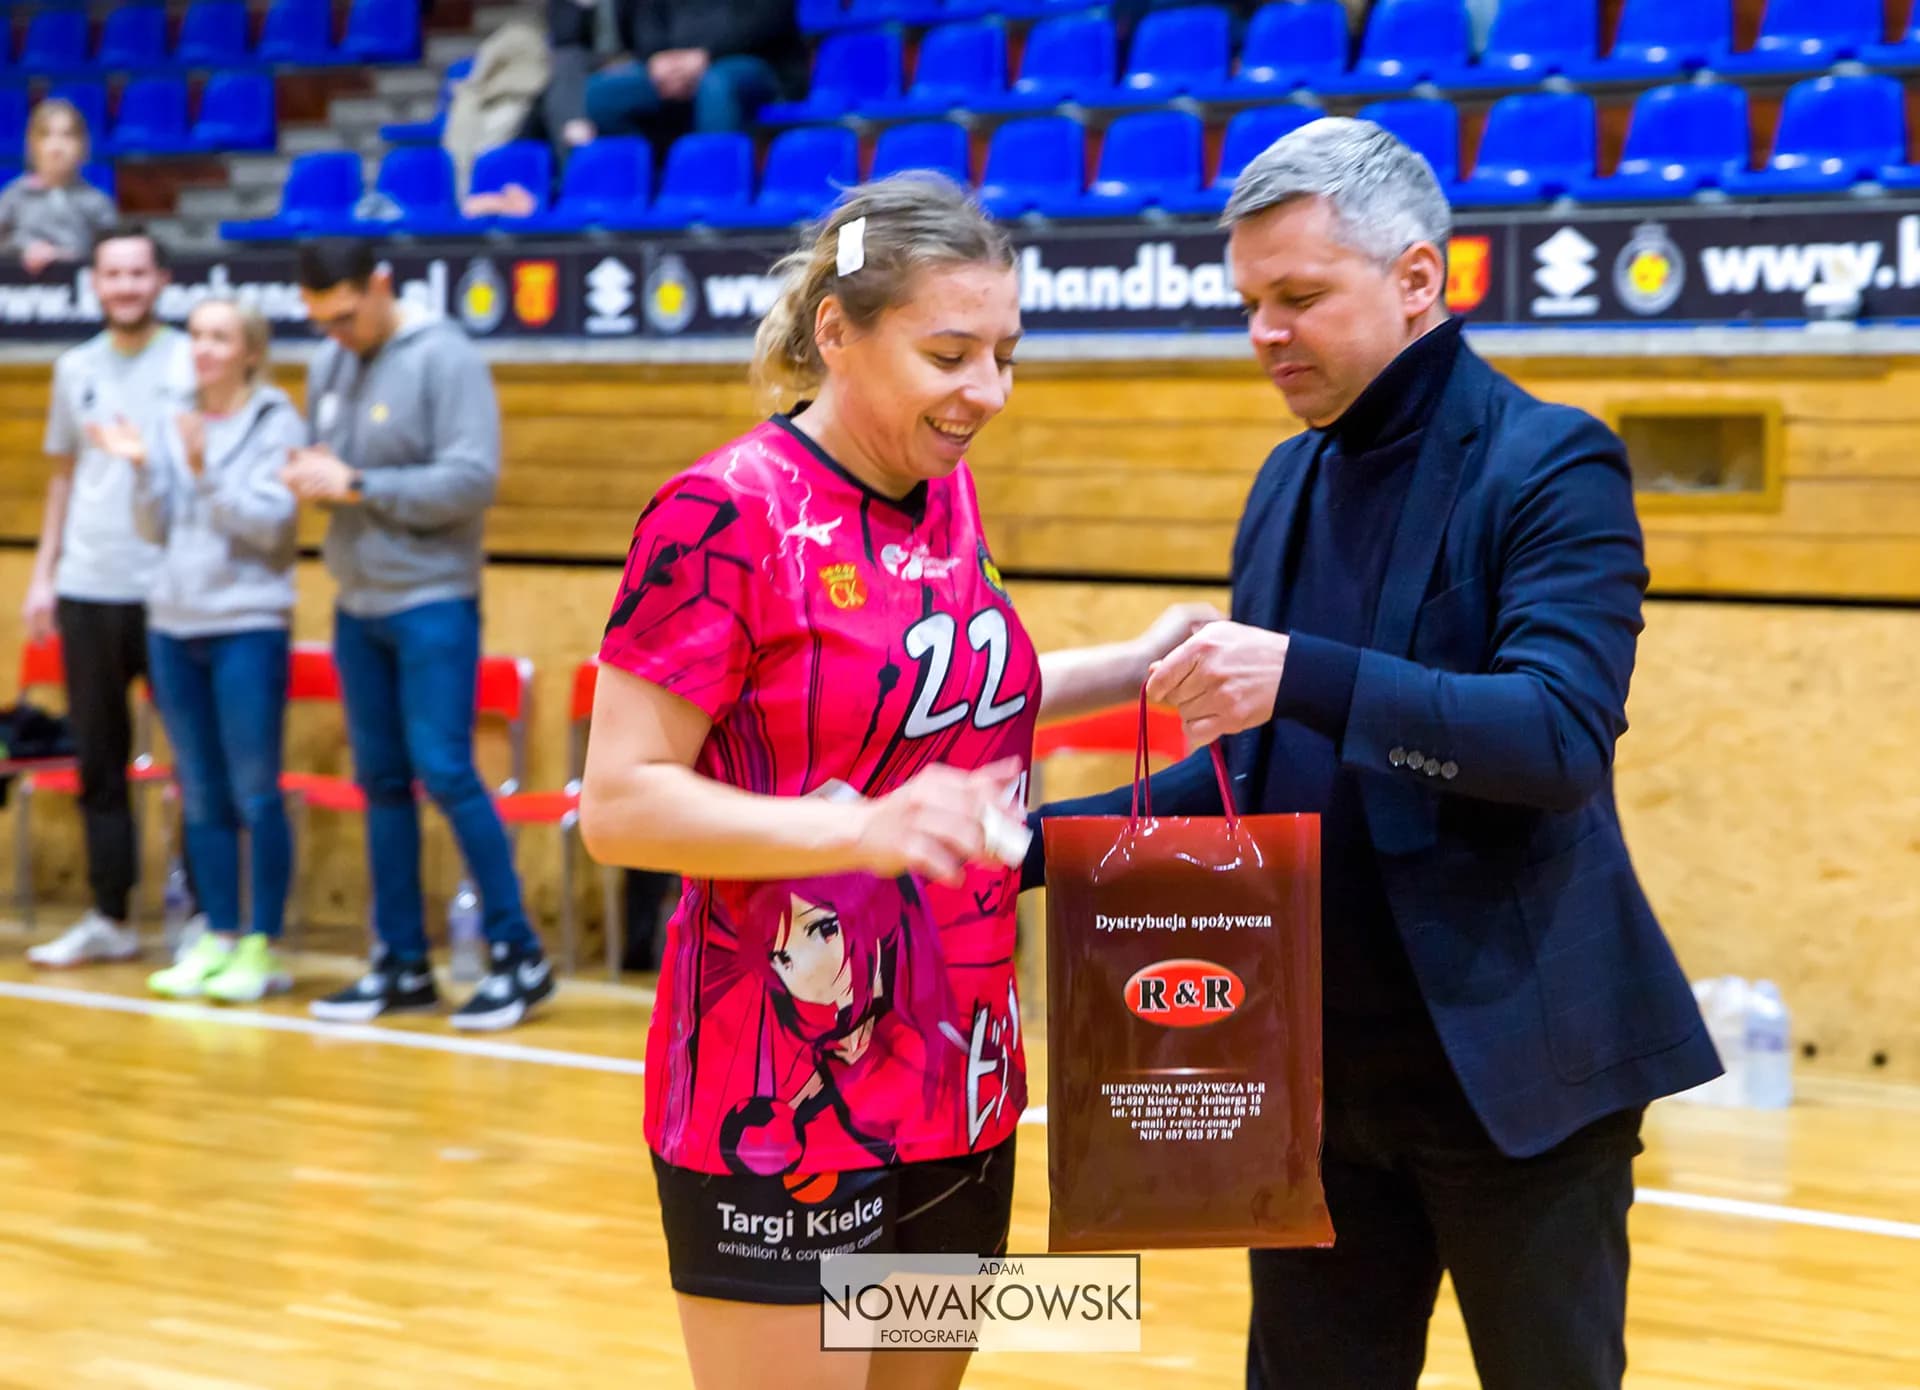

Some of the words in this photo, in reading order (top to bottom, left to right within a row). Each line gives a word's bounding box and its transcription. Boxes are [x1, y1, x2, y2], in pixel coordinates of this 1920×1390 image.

[903, 608, 1026, 739] 22
[1095, 913, 1187, 932] Dystrybucja
[1191, 912, 1272, 932] spożywcza
[1137, 976, 1170, 1012] R
[1174, 980, 1200, 1008] &
[1202, 975, 1235, 1012] R
[1101, 1083, 1172, 1095] HURTOWNIA
[1174, 1081, 1244, 1095] SPOŻYWCZA
[1147, 1095, 1182, 1106] Kielce,
[1184, 1094, 1199, 1105] ul.
[1201, 1094, 1247, 1107] Kolberga
[1112, 1107, 1129, 1118] tel.
[1130, 1107, 1141, 1118] 41
[1198, 1106, 1209, 1117] 41
[1131, 1118, 1167, 1129] e-mail:
[1140, 1129, 1163, 1141] NIP:
[716, 1201, 795, 1244] Targi
[806, 1196, 883, 1238] Kielce
[717, 1240, 778, 1261] exhibition
[781, 1246, 792, 1262] &
[795, 1241, 856, 1263] congress
